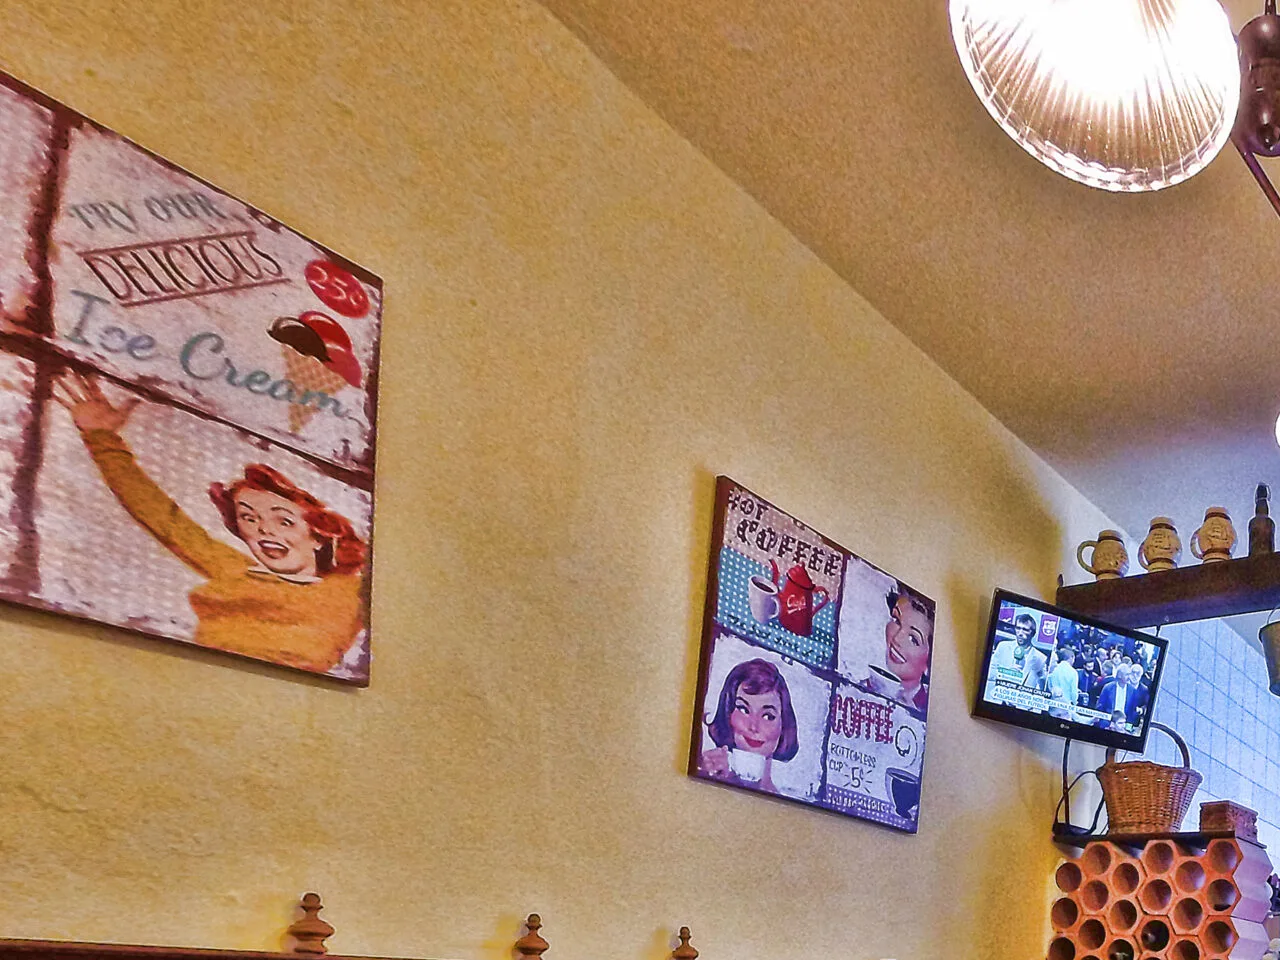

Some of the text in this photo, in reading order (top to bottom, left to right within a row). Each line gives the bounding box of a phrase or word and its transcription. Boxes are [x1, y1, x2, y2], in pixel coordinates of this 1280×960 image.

[68, 193, 227, 234] TRY OUR
[82, 238, 283, 300] DELICIOUS
[63, 289, 353, 418] Ice Cream
[736, 518, 842, 577] COFFEE
[830, 694, 894, 744] COFFEE
[829, 760, 844, 773] CUP
